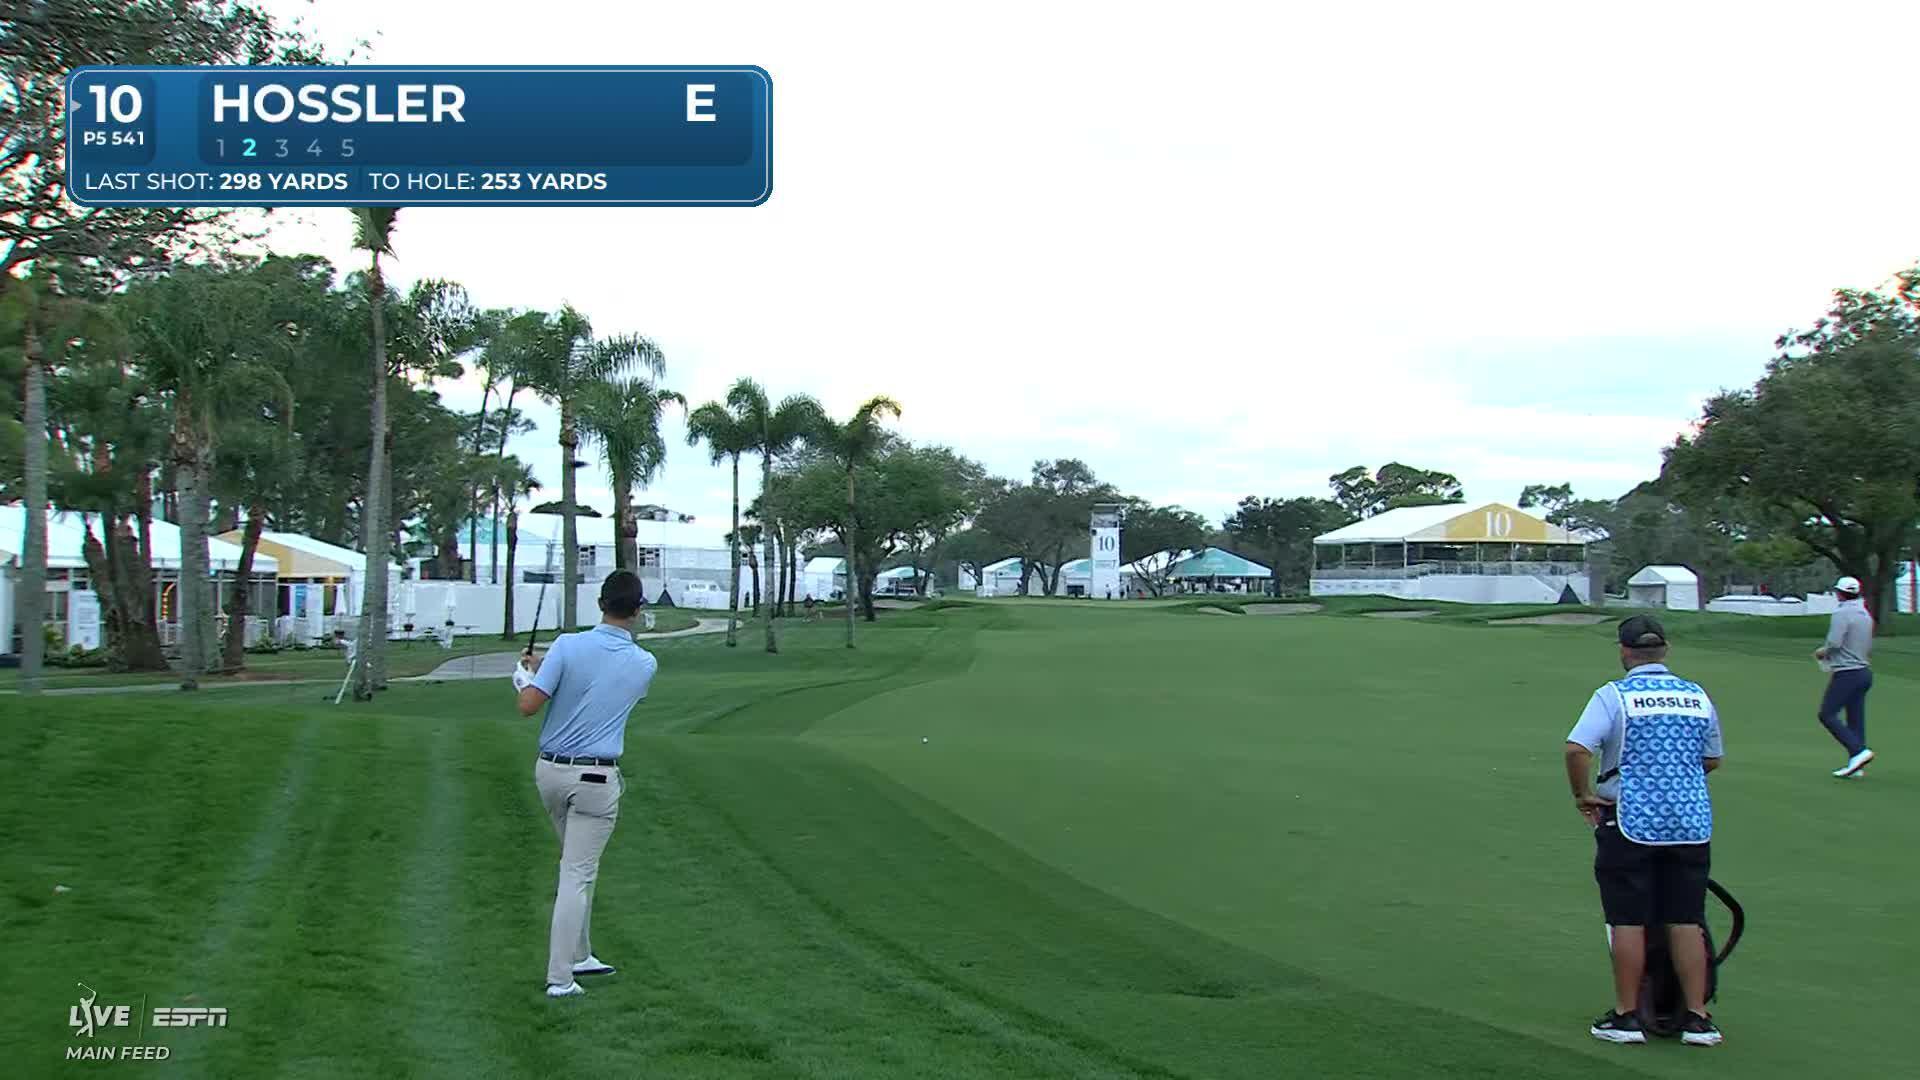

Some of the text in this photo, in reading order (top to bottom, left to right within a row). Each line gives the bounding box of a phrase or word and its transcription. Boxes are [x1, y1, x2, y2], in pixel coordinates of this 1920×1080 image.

[1485, 511, 1512, 538] 10
[1098, 536, 1115, 551] 10
[1633, 697, 1702, 710] HOSSLER
